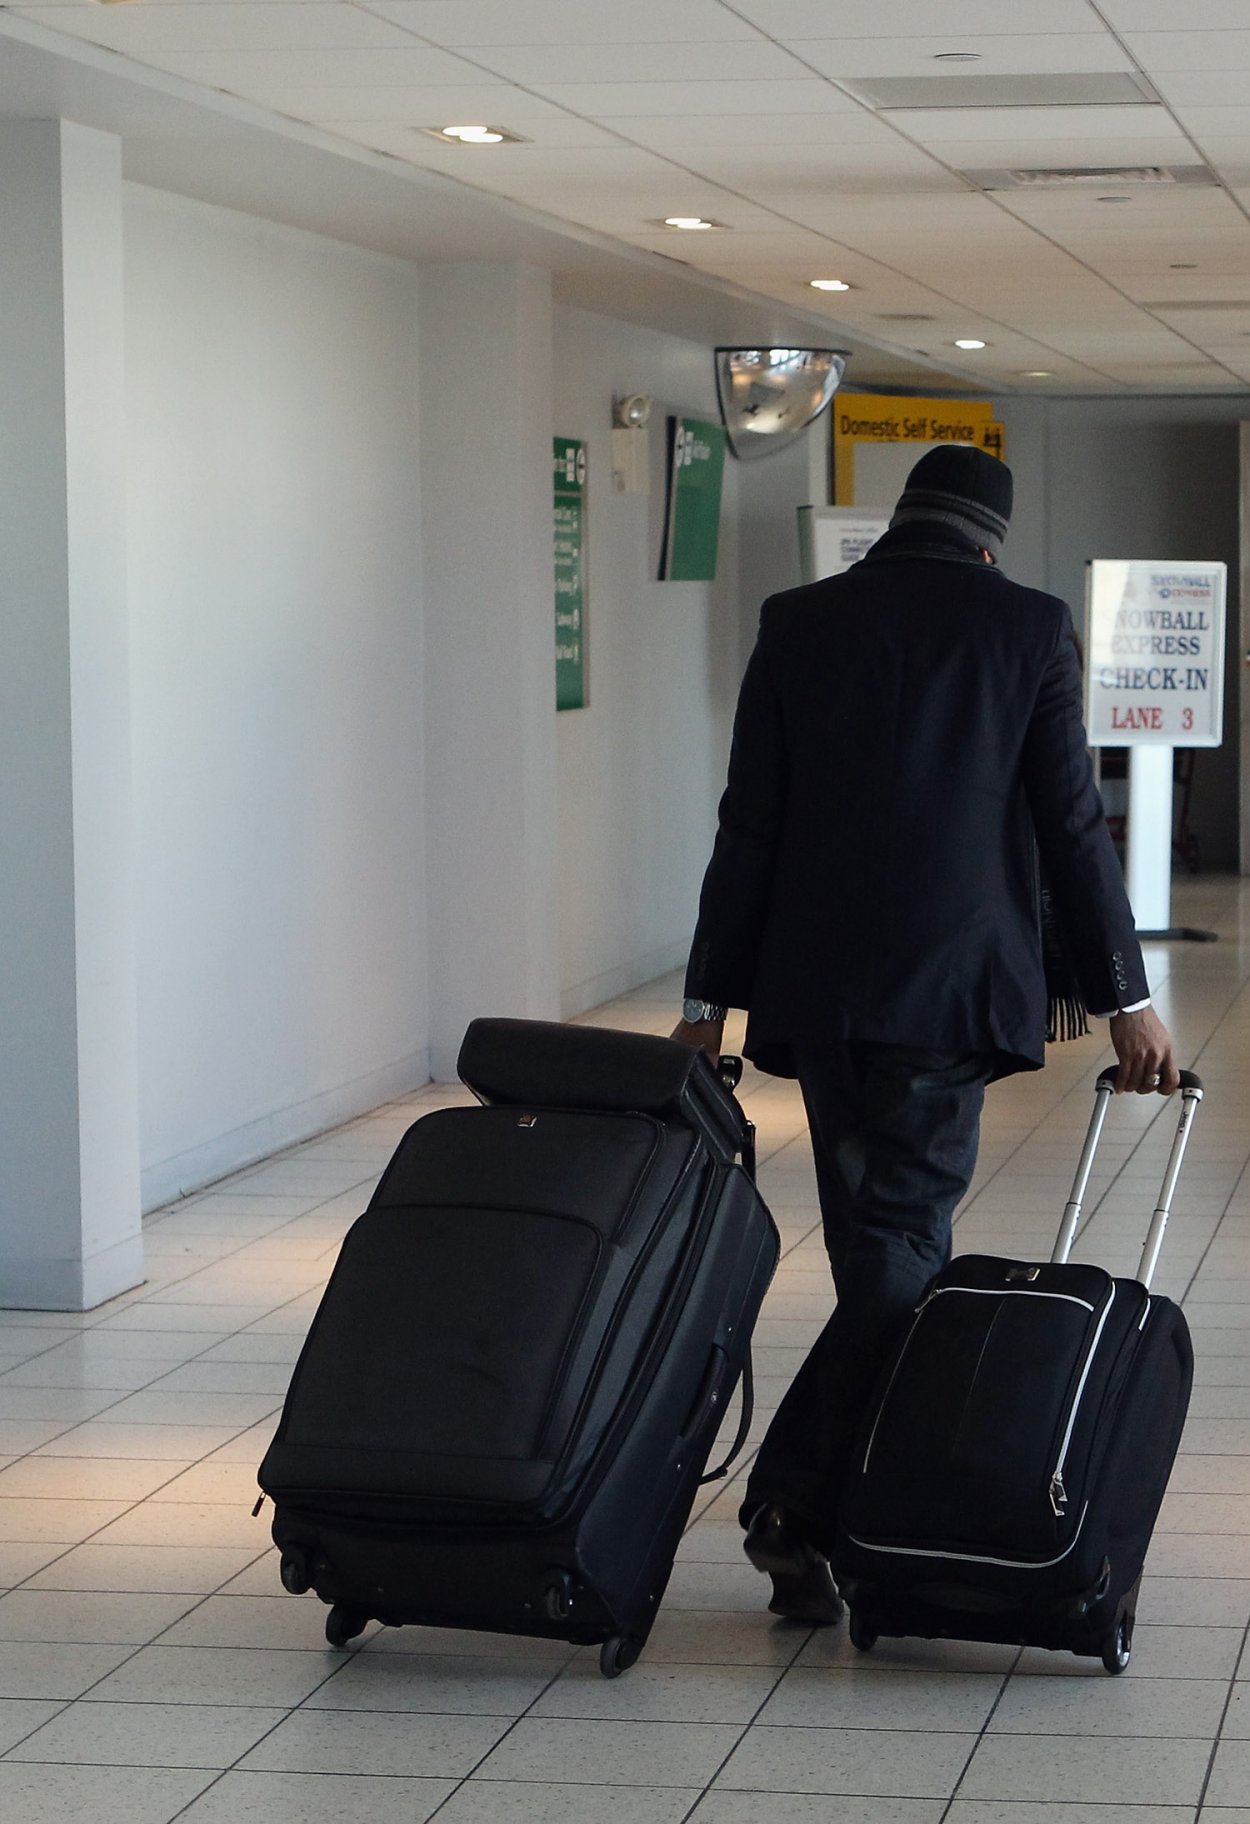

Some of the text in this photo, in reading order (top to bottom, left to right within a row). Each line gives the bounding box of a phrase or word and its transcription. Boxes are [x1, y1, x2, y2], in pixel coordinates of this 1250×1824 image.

[841, 414, 975, 441] Domestic Self Service
[1106, 610, 1209, 630] NOWBALL
[1111, 635, 1201, 656] EXPRESS
[1100, 668, 1208, 690] CHECK-IN
[1111, 707, 1194, 729] LANE 3
